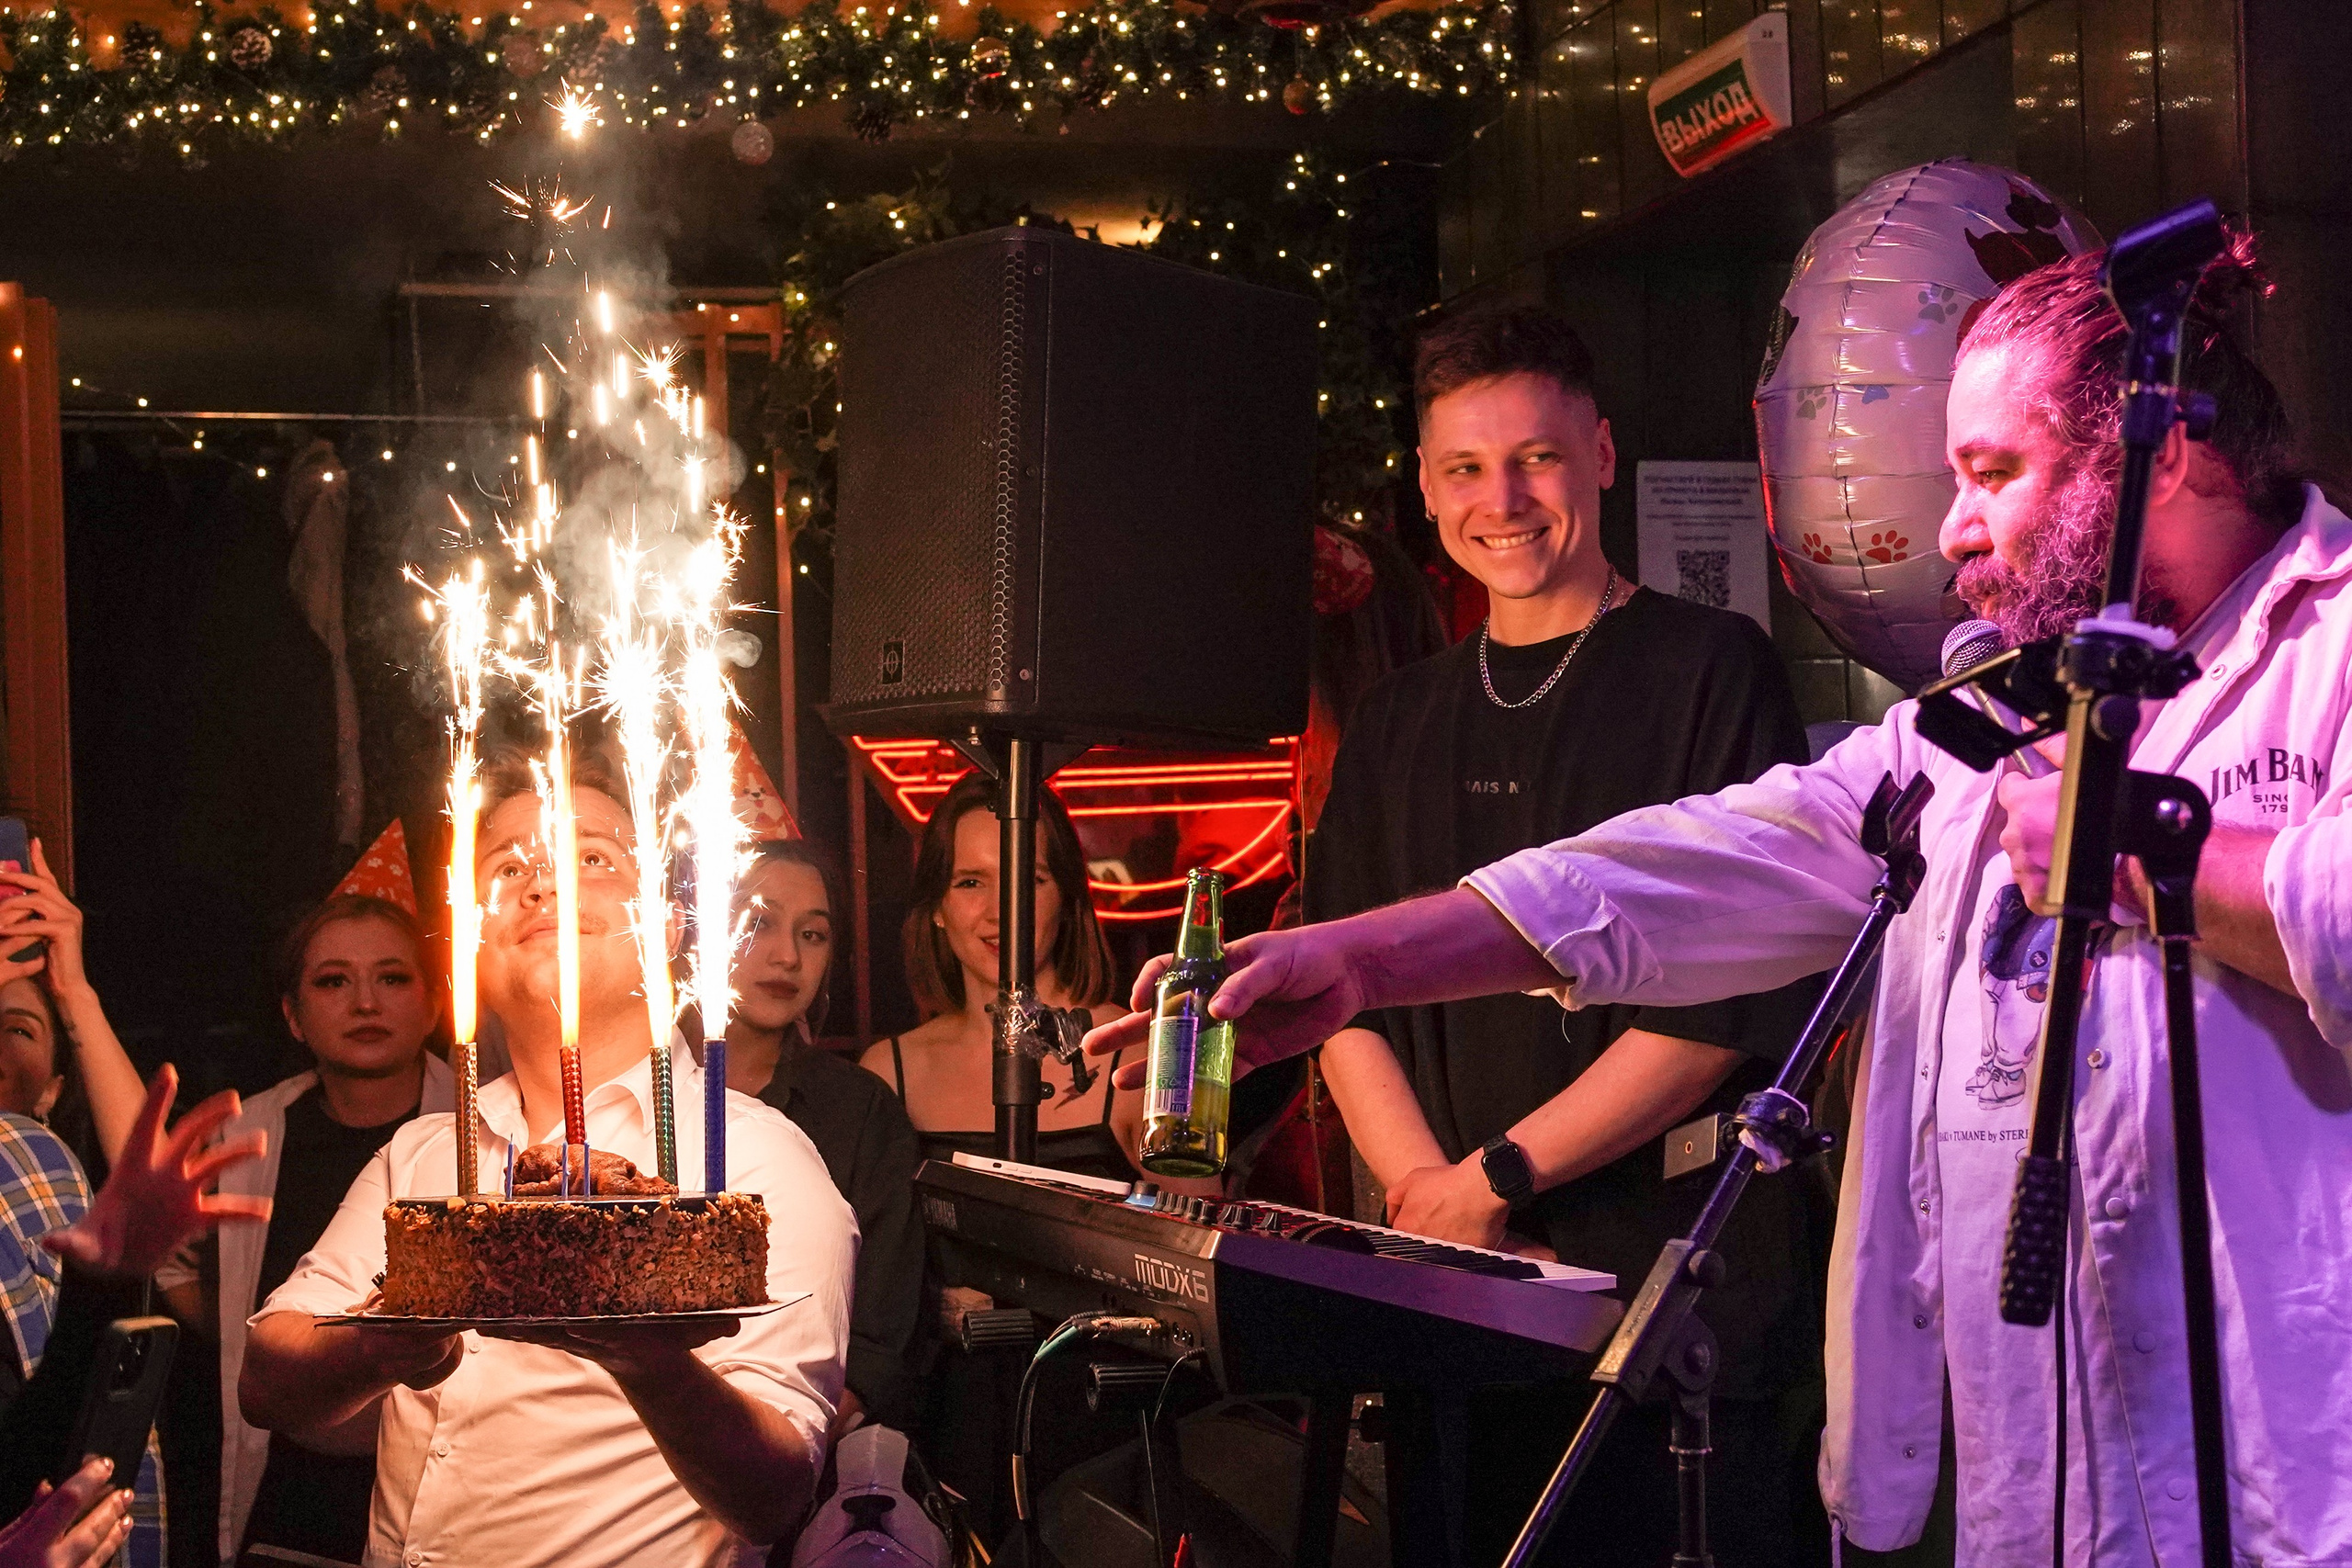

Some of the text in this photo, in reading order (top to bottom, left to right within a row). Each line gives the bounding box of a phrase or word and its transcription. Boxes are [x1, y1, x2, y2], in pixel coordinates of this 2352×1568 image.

[1661, 81, 1761, 153] ВЫХОД
[2211, 758, 2260, 808] JIM
[1953, 1131, 1986, 1142] TUMANE
[1987, 1131, 1996, 1144] by
[1134, 1253, 1210, 1303] MODX6
